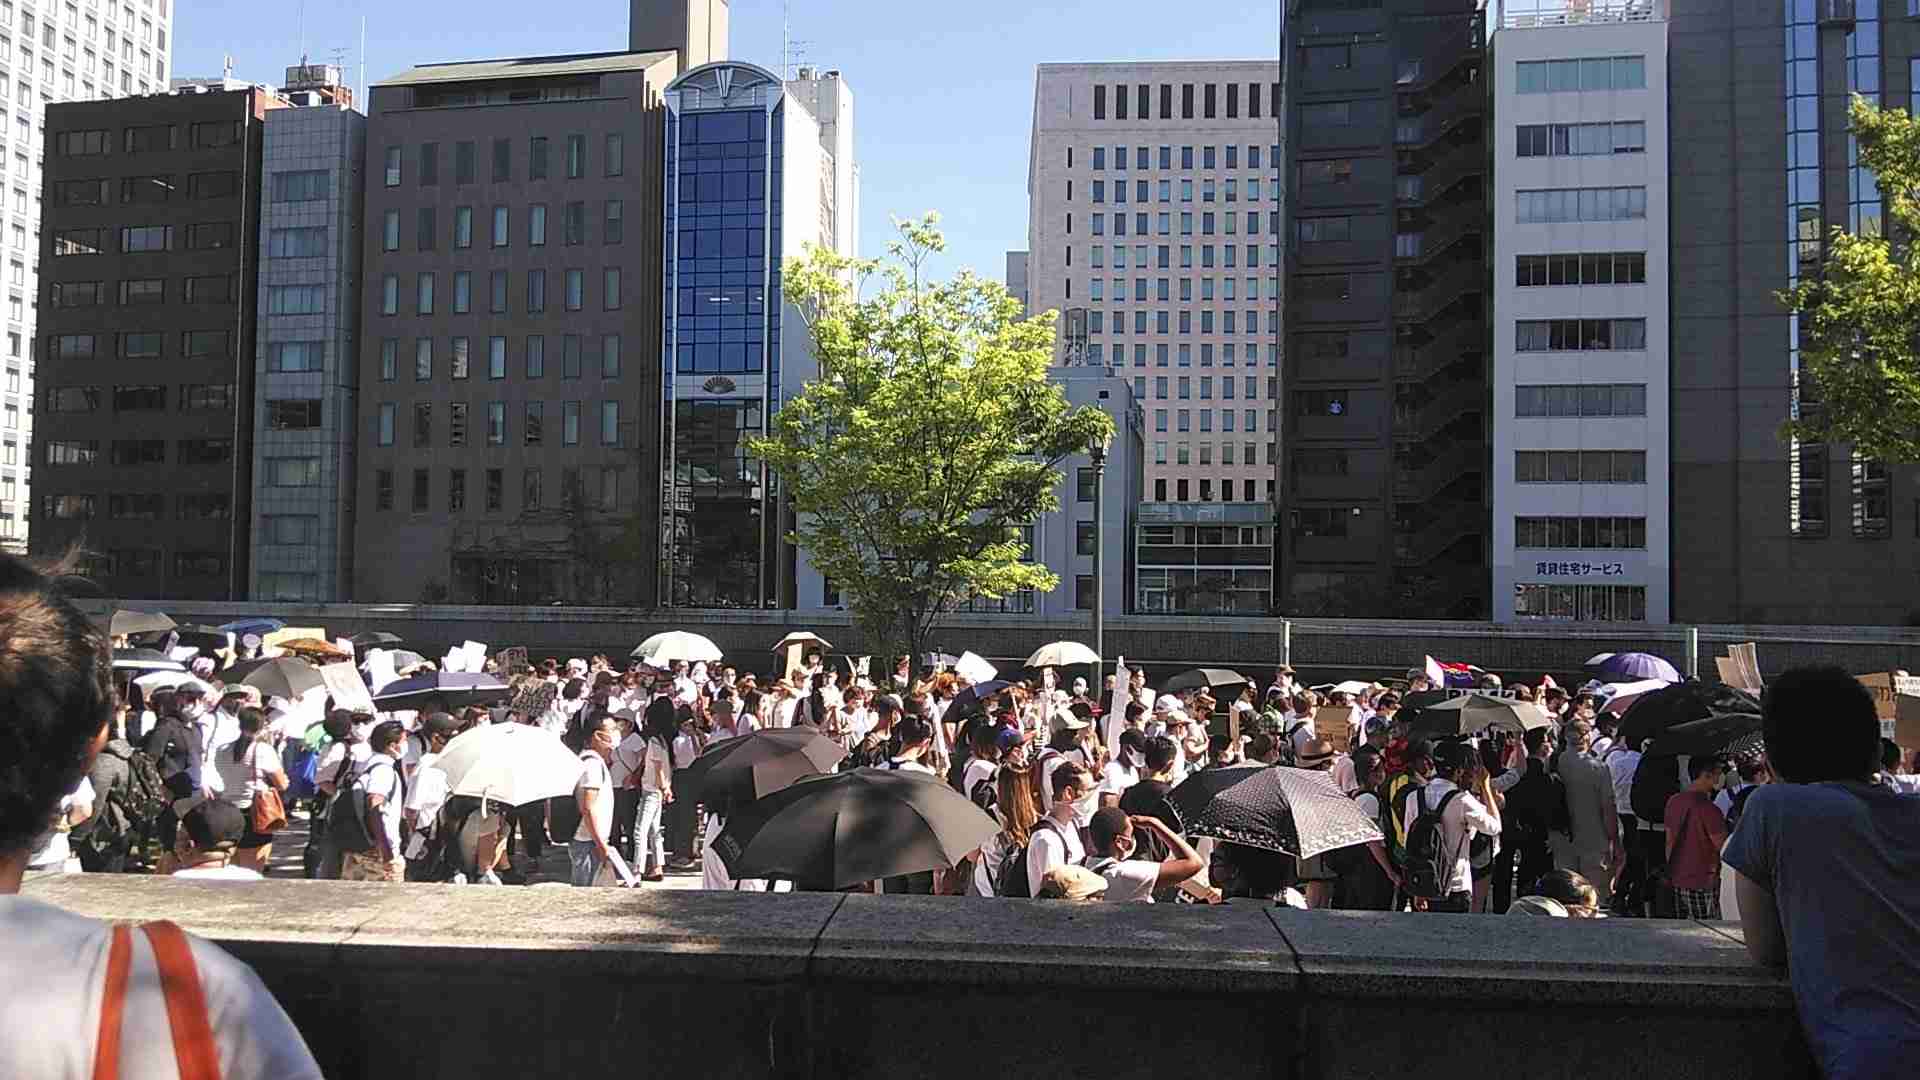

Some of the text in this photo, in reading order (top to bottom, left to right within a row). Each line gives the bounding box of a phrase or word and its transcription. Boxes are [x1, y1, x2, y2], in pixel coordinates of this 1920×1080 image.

[1536, 562, 1624, 575] 賃貸住宅サービス
